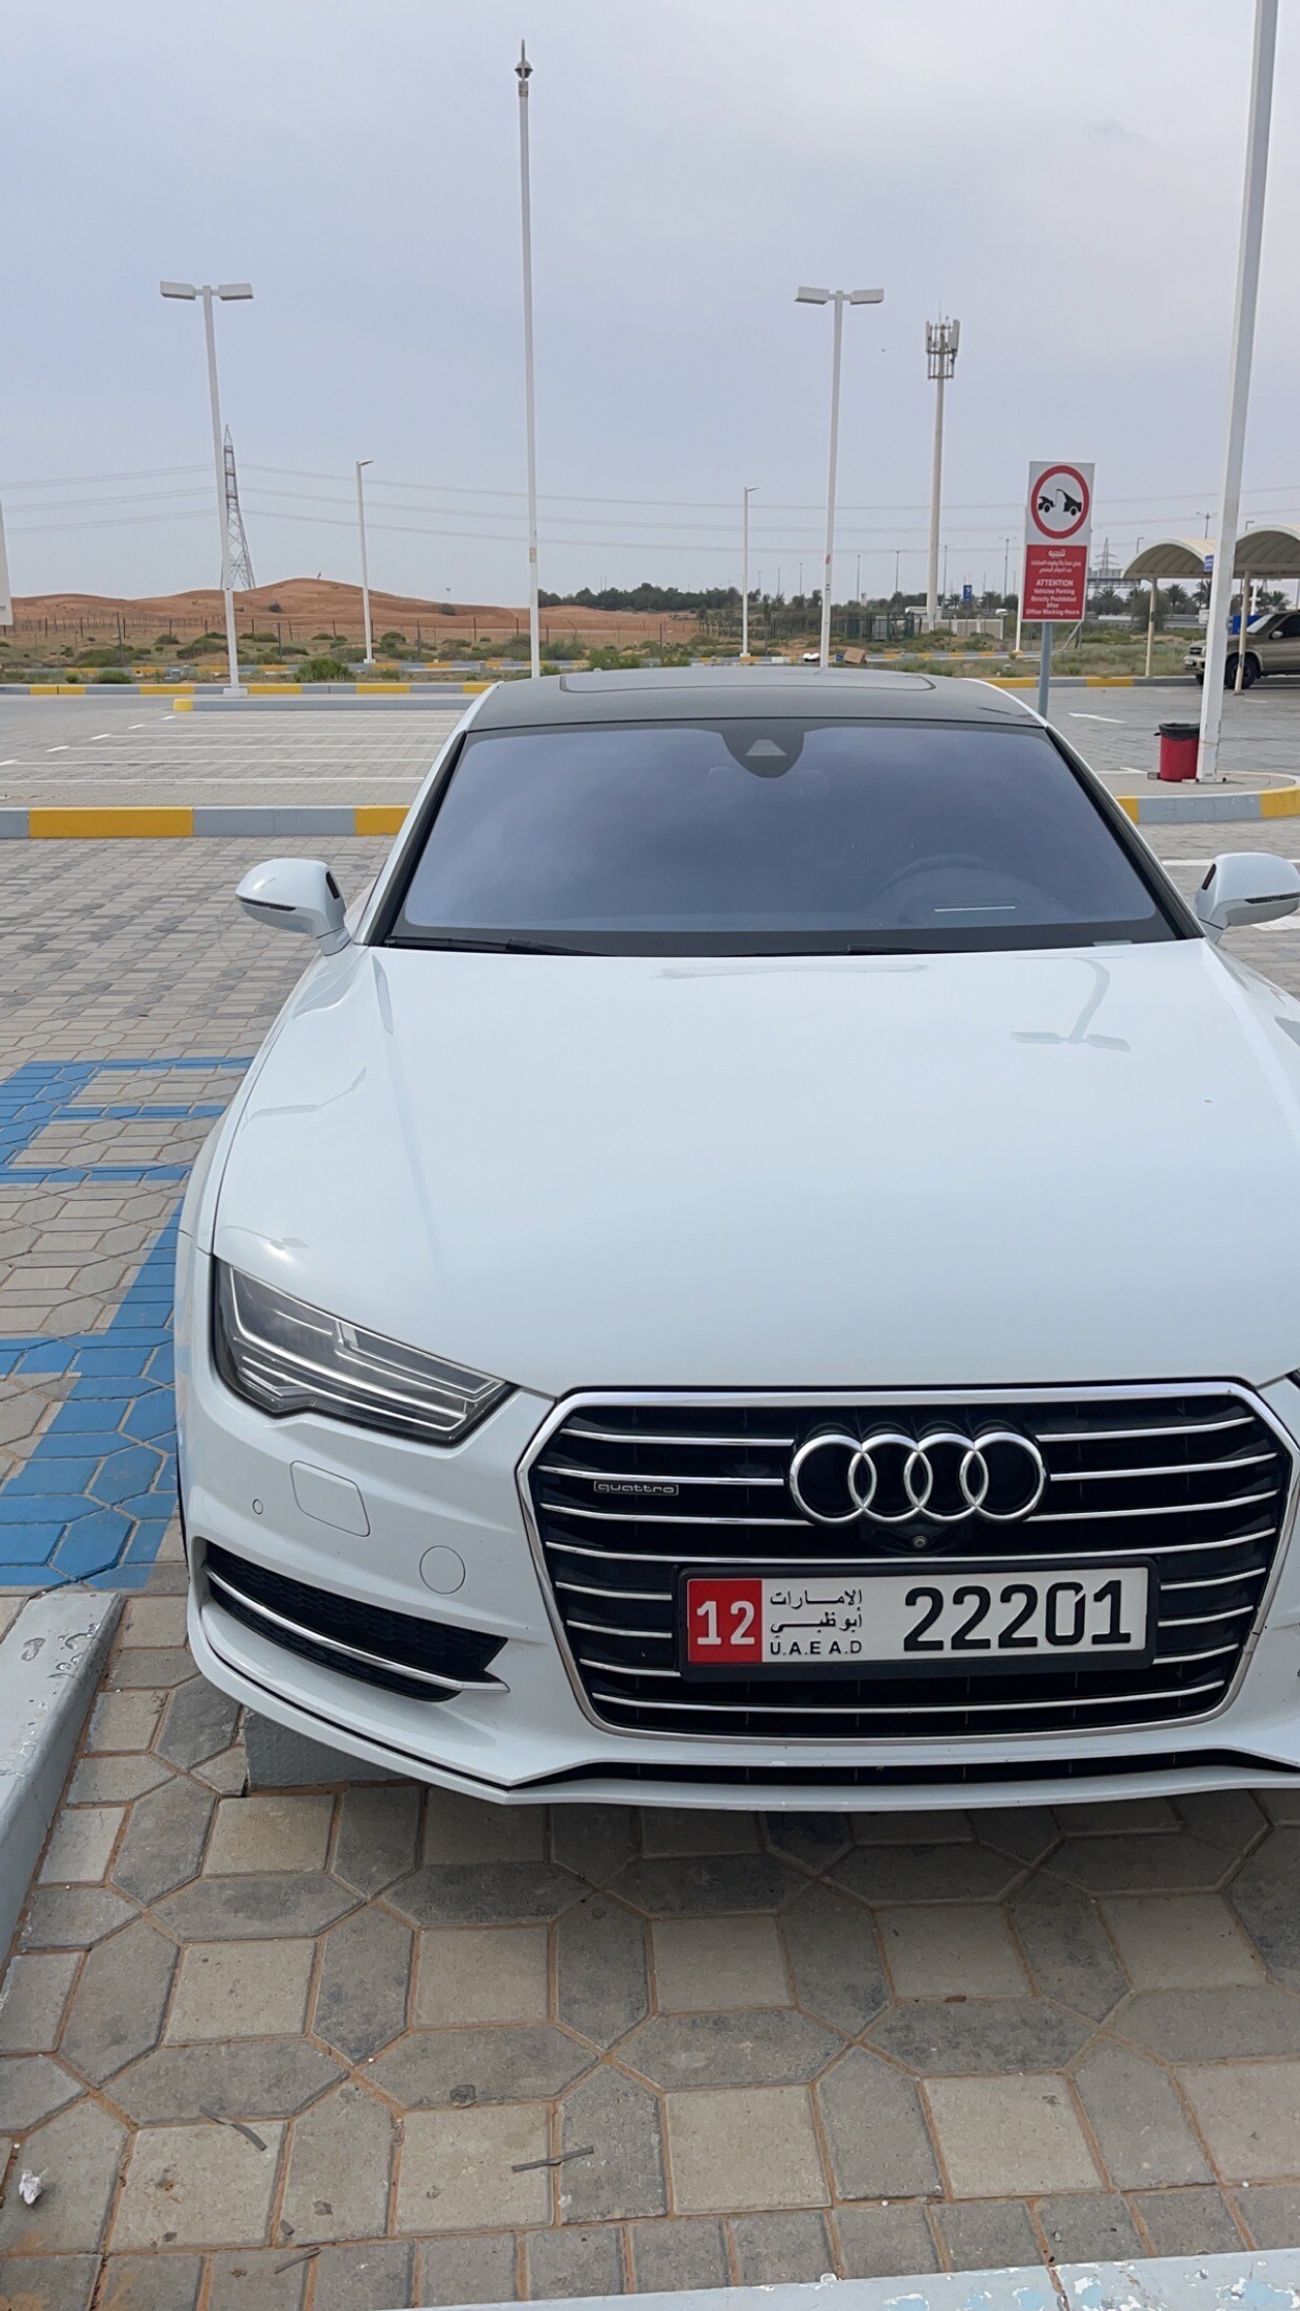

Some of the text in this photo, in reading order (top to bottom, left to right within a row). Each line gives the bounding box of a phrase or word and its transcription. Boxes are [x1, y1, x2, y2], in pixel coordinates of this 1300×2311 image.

[1036, 579, 1074, 587] ATTENTION
[597, 1483, 675, 1493] quattro
[696, 1600, 755, 1646] 12
[903, 1579, 1131, 1652] 22201
